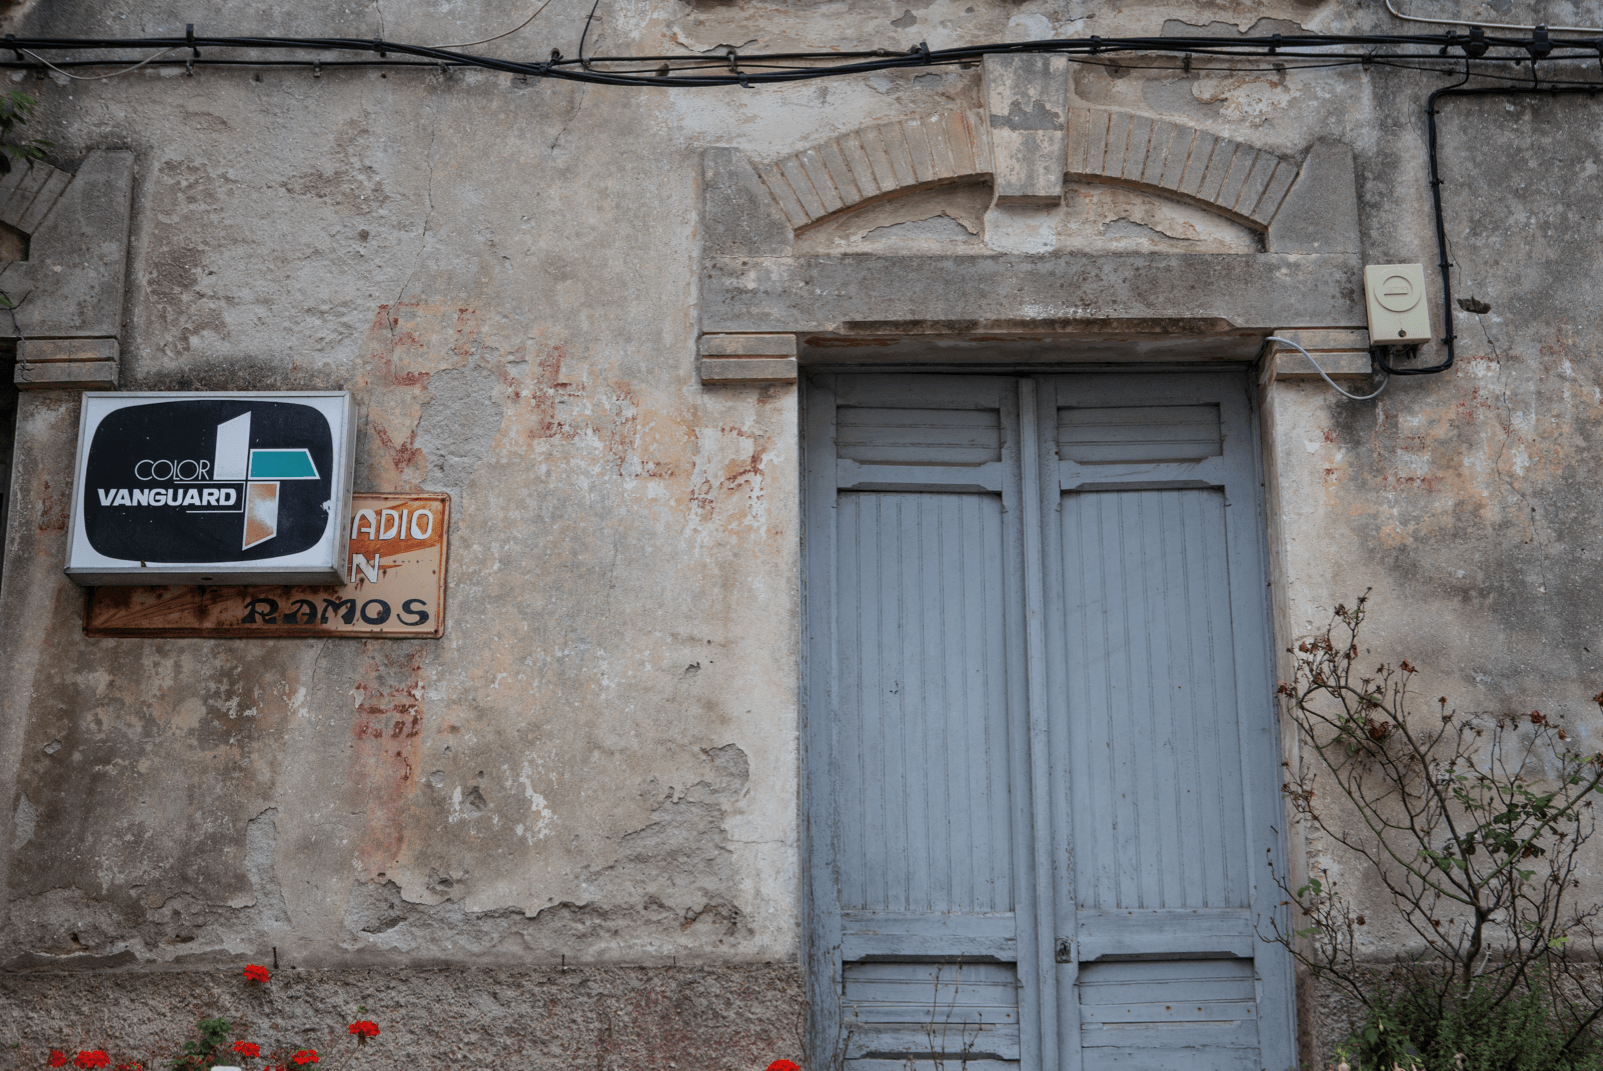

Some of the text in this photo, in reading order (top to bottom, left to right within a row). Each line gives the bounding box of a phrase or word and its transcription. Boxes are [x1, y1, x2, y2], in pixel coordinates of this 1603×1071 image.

[134, 459, 210, 481] COLOR
[97, 488, 237, 506] VANGUARD
[351, 508, 434, 541] ADIO
[241, 598, 430, 626] RAMOS
